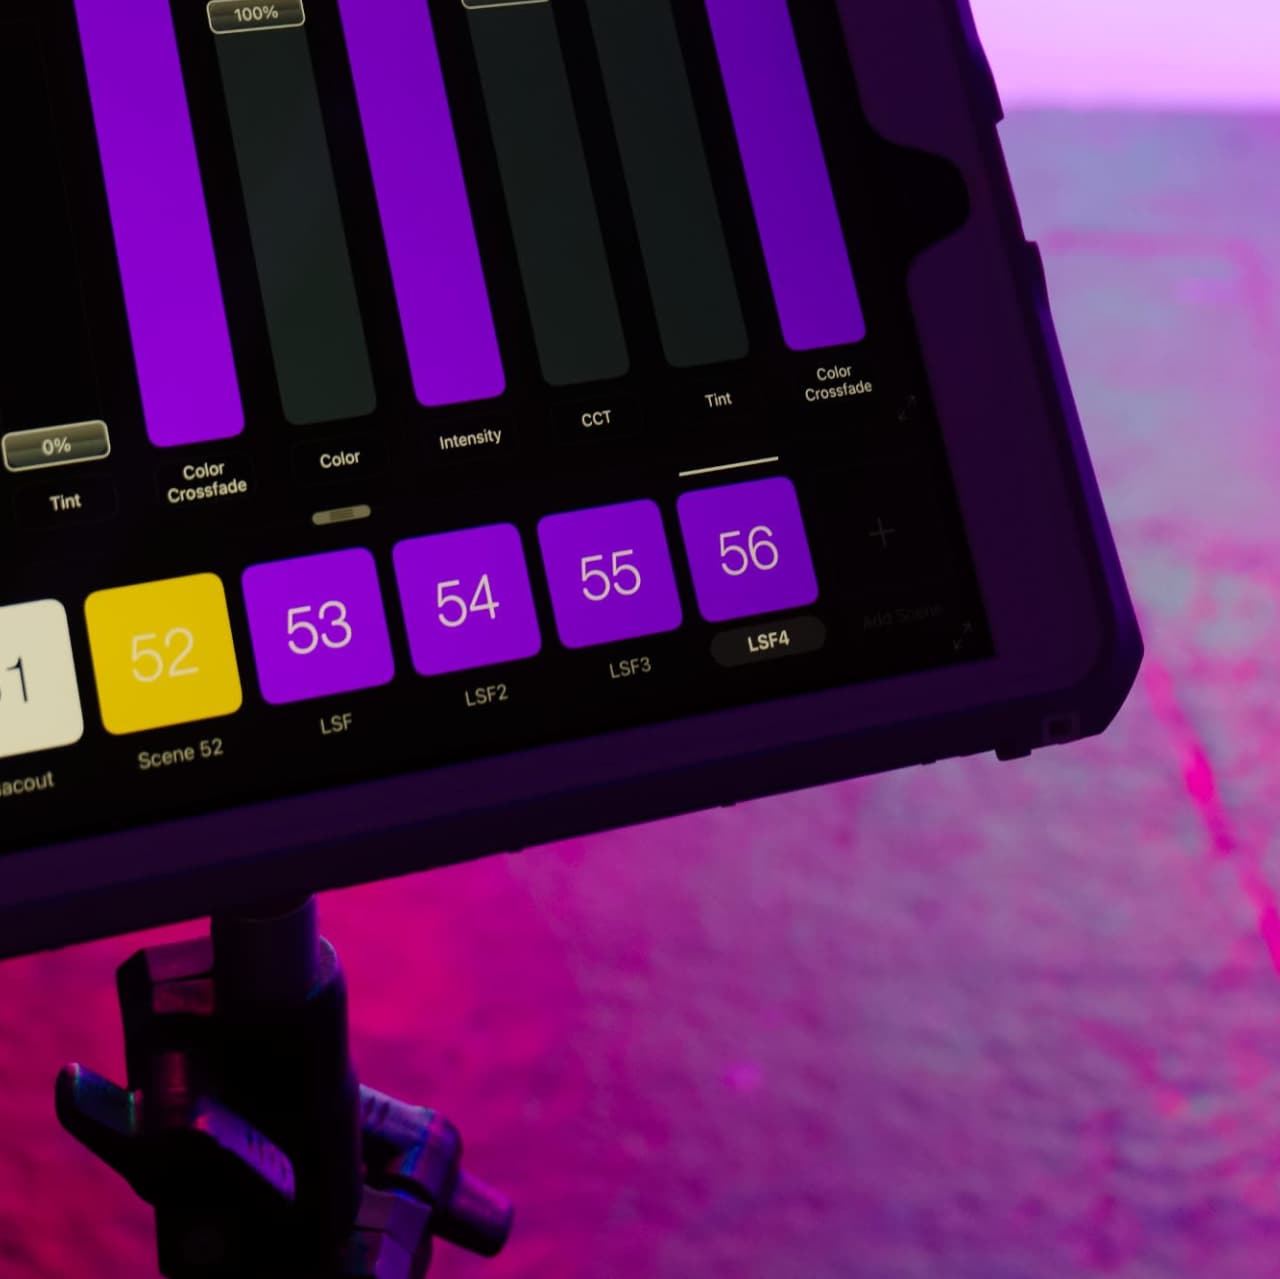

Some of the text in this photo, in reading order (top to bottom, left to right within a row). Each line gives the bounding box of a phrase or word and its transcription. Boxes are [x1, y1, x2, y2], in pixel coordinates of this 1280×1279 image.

[233, 5, 279, 23] 100%
[816, 364, 852, 381] Color
[704, 391, 732, 409] Tint
[805, 378, 873, 403] Crossfade
[581, 410, 612, 428] CCT
[41, 436, 72, 456] 0%
[439, 427, 502, 451] Intensity
[183, 462, 224, 481] Color
[320, 449, 360, 470] Color
[49, 492, 82, 512] Tint
[167, 477, 247, 504] Crossfade
[719, 525, 780, 577] 56
[580, 549, 641, 602] 55
[436, 573, 500, 628] 54
[286, 600, 353, 656] 53
[747, 630, 791, 653] LSF4
[130, 627, 199, 683] 52
[609, 656, 652, 680] LSF3
[465, 683, 509, 708] LSF2
[320, 713, 354, 735] LSF
[137, 737, 224, 771] Scene 52
